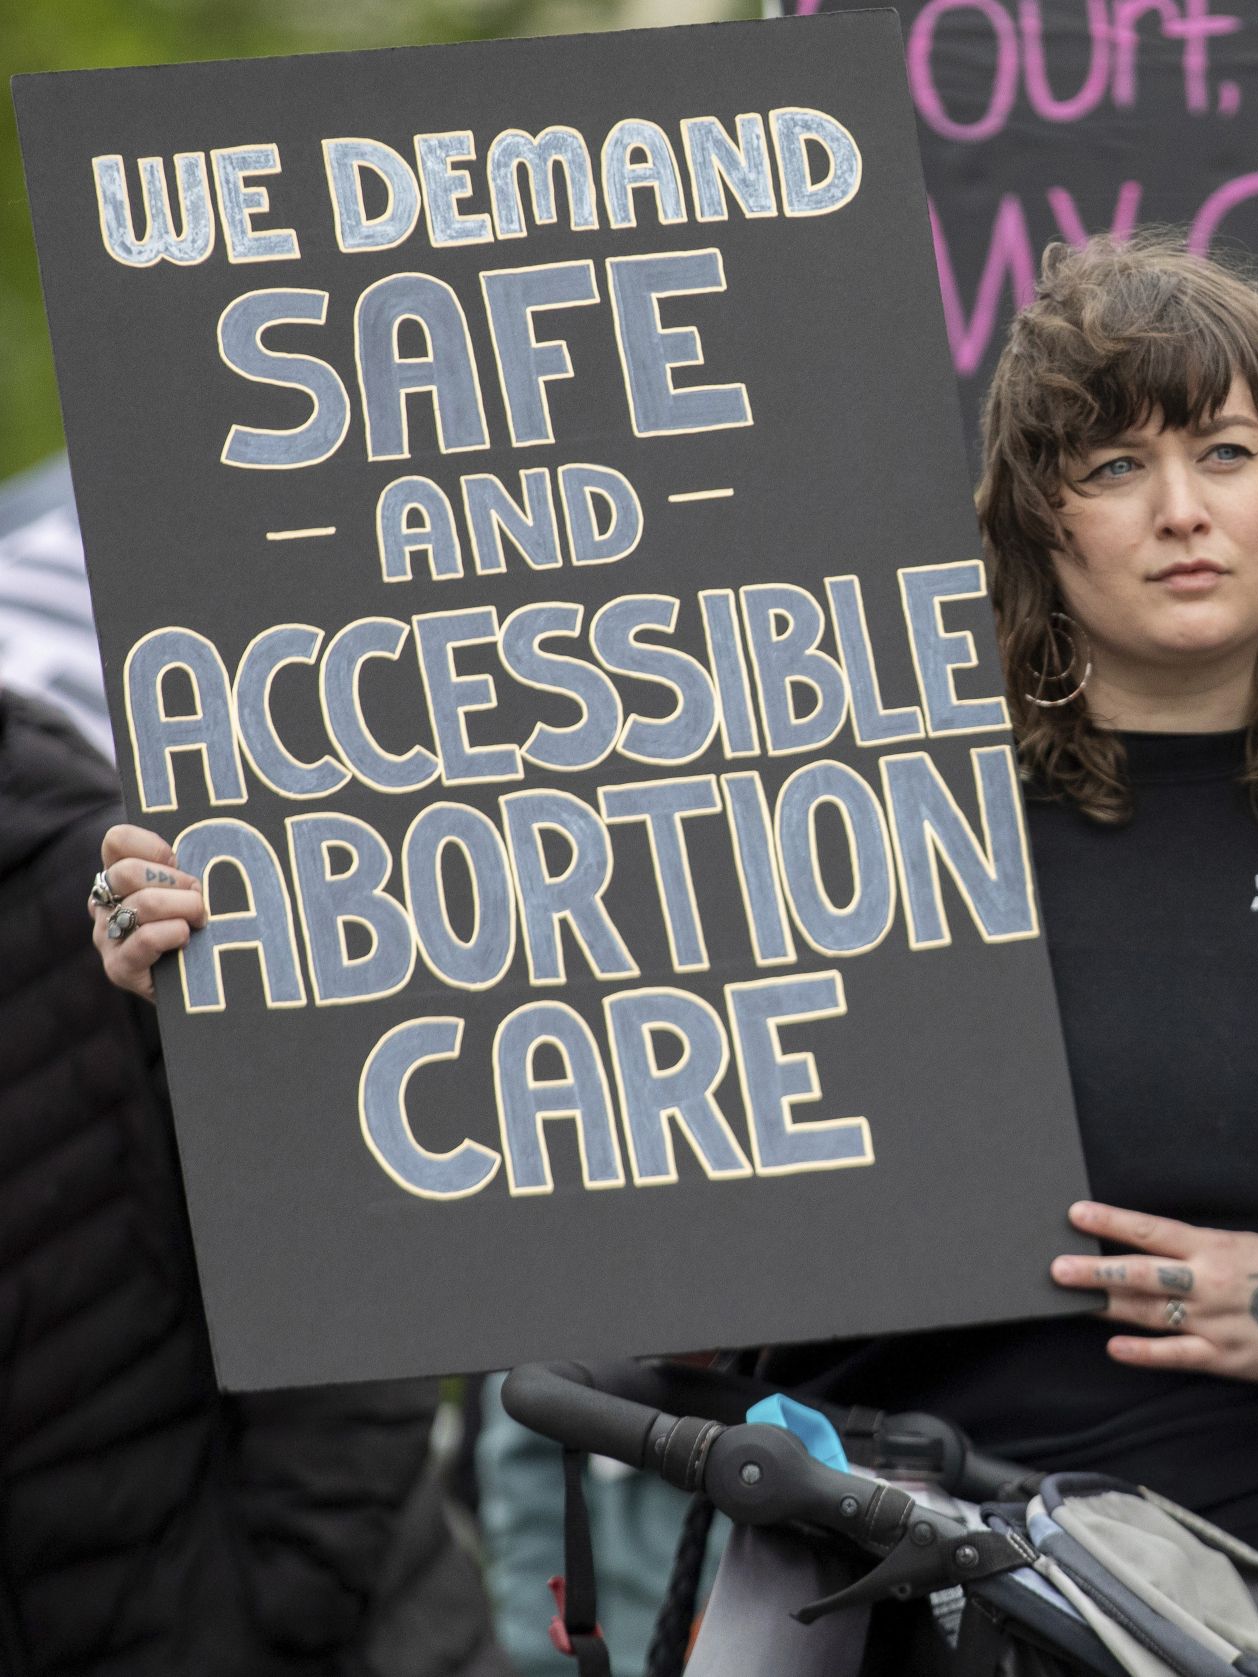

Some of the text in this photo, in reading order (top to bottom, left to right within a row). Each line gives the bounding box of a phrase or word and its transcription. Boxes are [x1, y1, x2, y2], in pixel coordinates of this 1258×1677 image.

[92, 107, 863, 268] WE DEMAND
[217, 247, 754, 470] SAFE
[376, 463, 644, 582] AND
[124, 560, 1011, 813] ACCESSIBLE
[171, 744, 1041, 1013] ABORTION
[357, 968, 875, 1199] CARE
